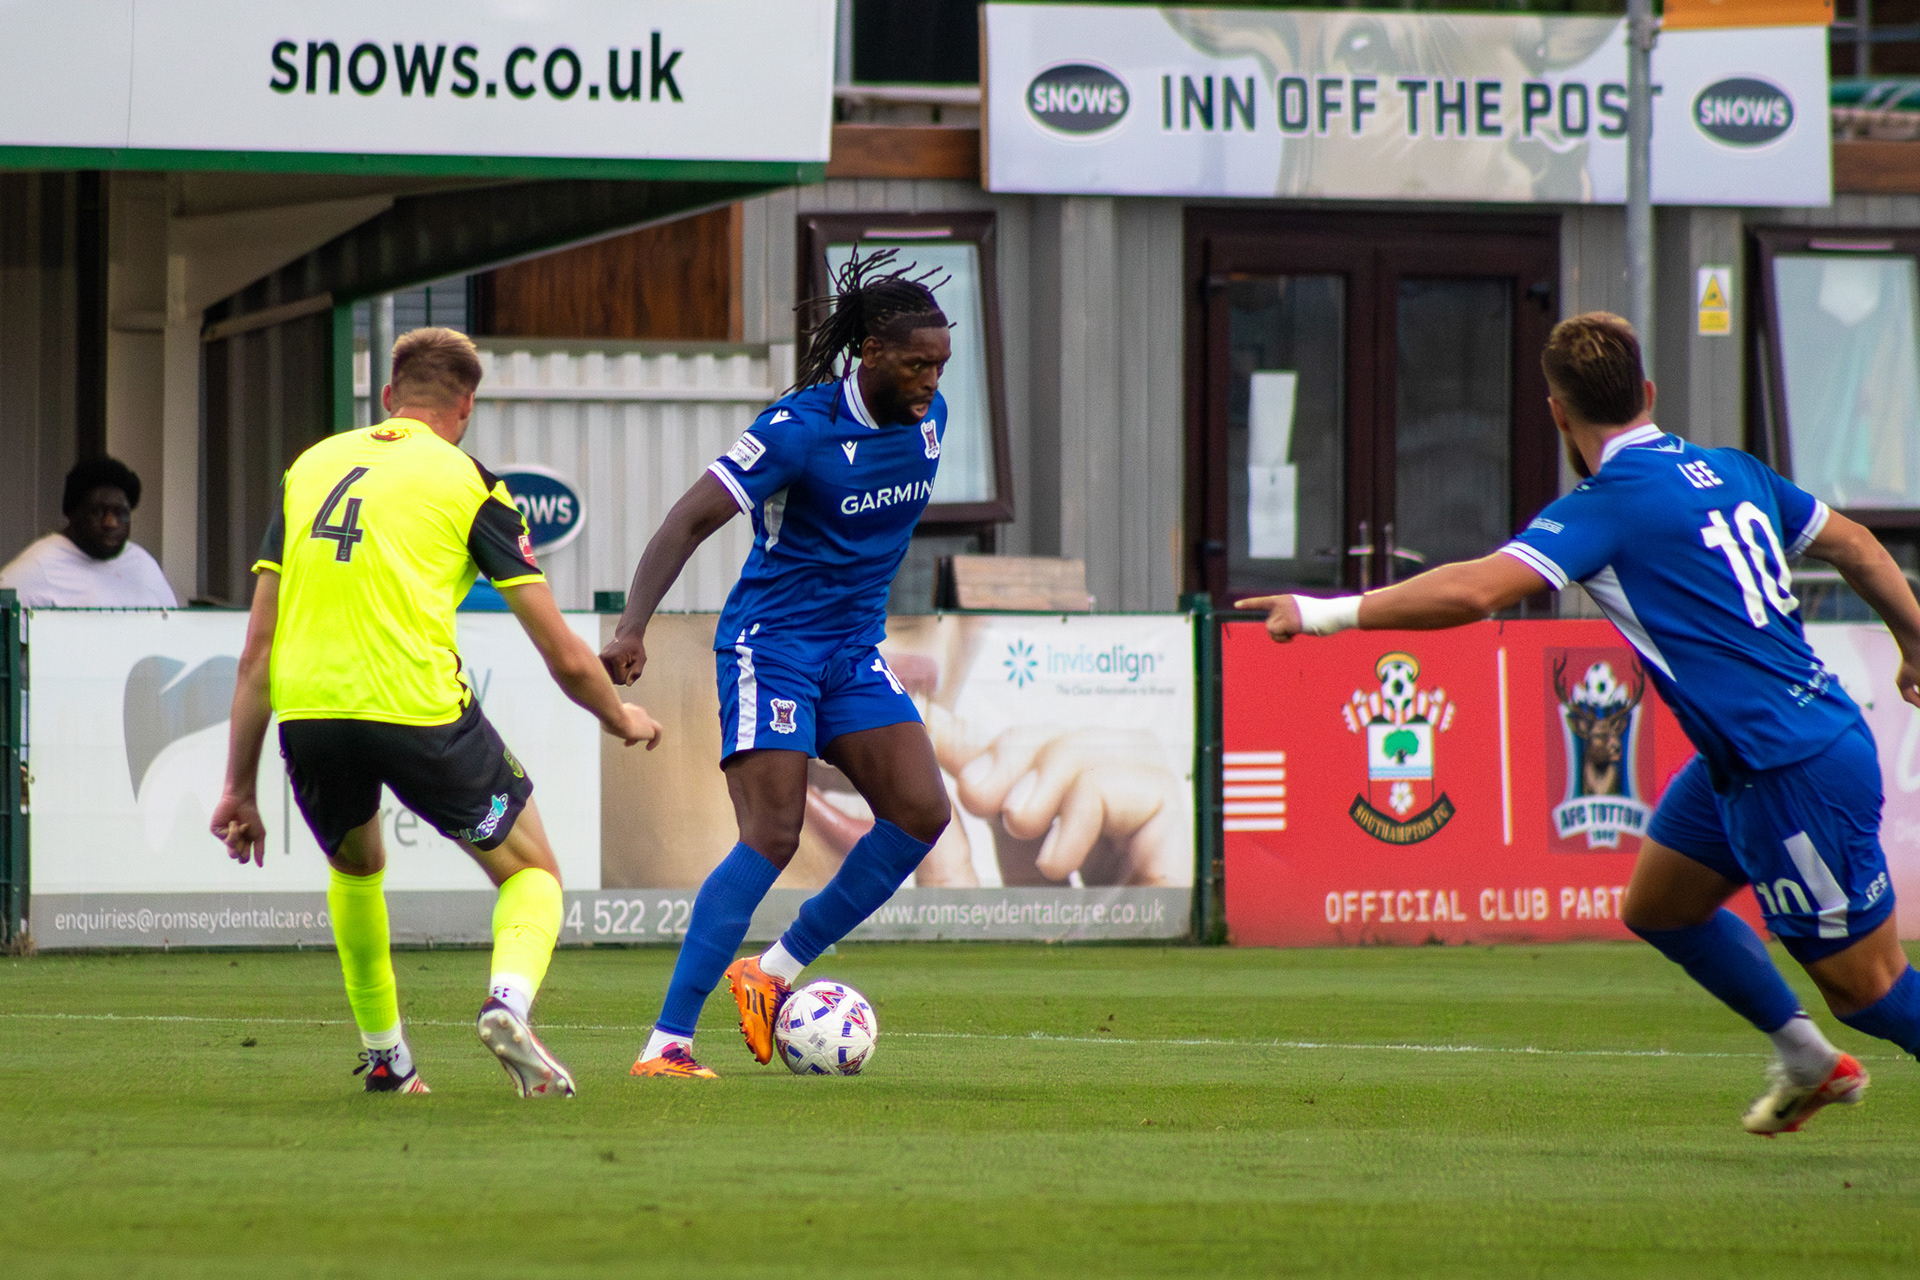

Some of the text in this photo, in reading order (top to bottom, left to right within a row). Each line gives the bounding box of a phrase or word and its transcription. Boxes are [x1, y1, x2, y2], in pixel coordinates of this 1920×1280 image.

[269, 30, 684, 102] snows.co.uk
[1032, 84, 1124, 115] SNOWS
[1162, 75, 1256, 131] INN
[1278, 76, 1378, 137] OFF
[1397, 79, 1502, 137] THE
[1700, 96, 1788, 126] SNOWS
[1676, 460, 1723, 489] LEE
[311, 466, 370, 562] 4
[513, 494, 573, 525] OWS
[840, 477, 935, 515] GARMIN
[1700, 501, 1799, 628] 10
[1046, 644, 1156, 682] invisalign
[1354, 801, 1450, 842] SOUTHAMPTON FC
[1560, 803, 1644, 830] AFC TOTTON
[594, 899, 645, 934] 522
[657, 899, 696, 934] 22
[1324, 886, 1629, 923] OFFICIAL CLUB PART
